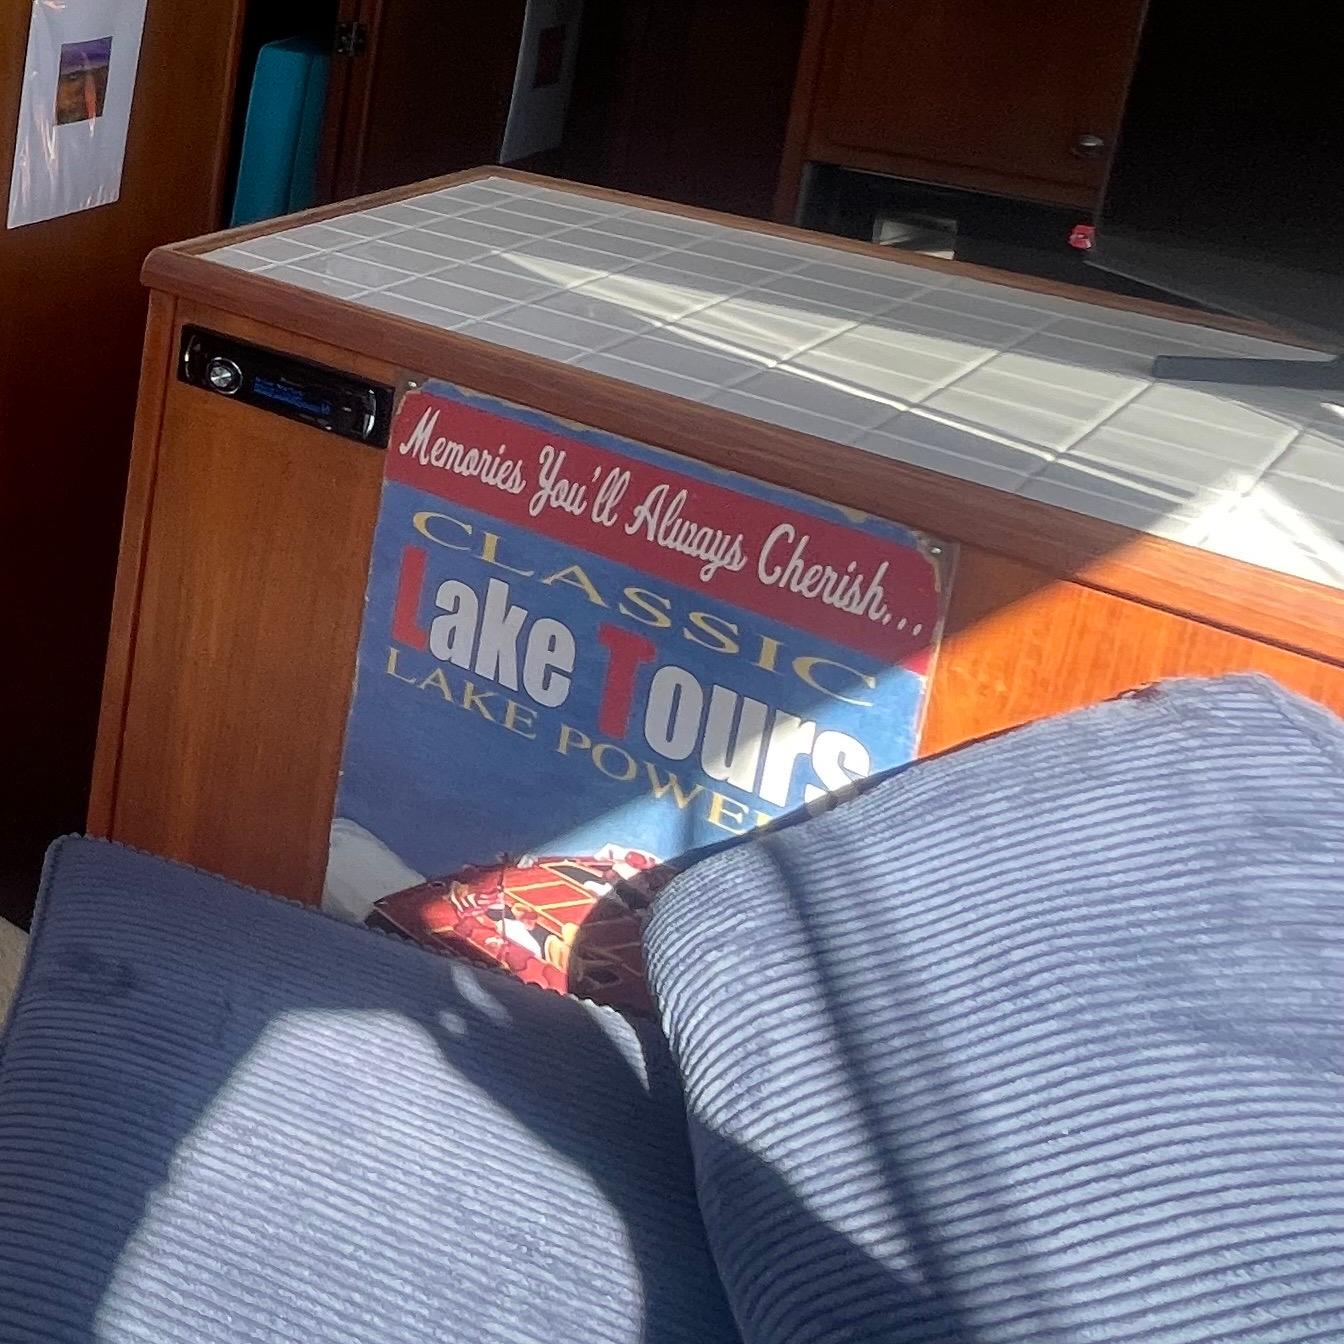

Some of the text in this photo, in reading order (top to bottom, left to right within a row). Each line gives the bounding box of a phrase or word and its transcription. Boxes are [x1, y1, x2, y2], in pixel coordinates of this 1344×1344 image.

[399, 406, 526, 494] Memories
[528, 445, 631, 527] You'll
[624, 484, 748, 582] Always
[391, 545, 872, 808] Lake Tours
[412, 510, 876, 707] CLASSIC
[385, 646, 774, 836] LAKE POWE
